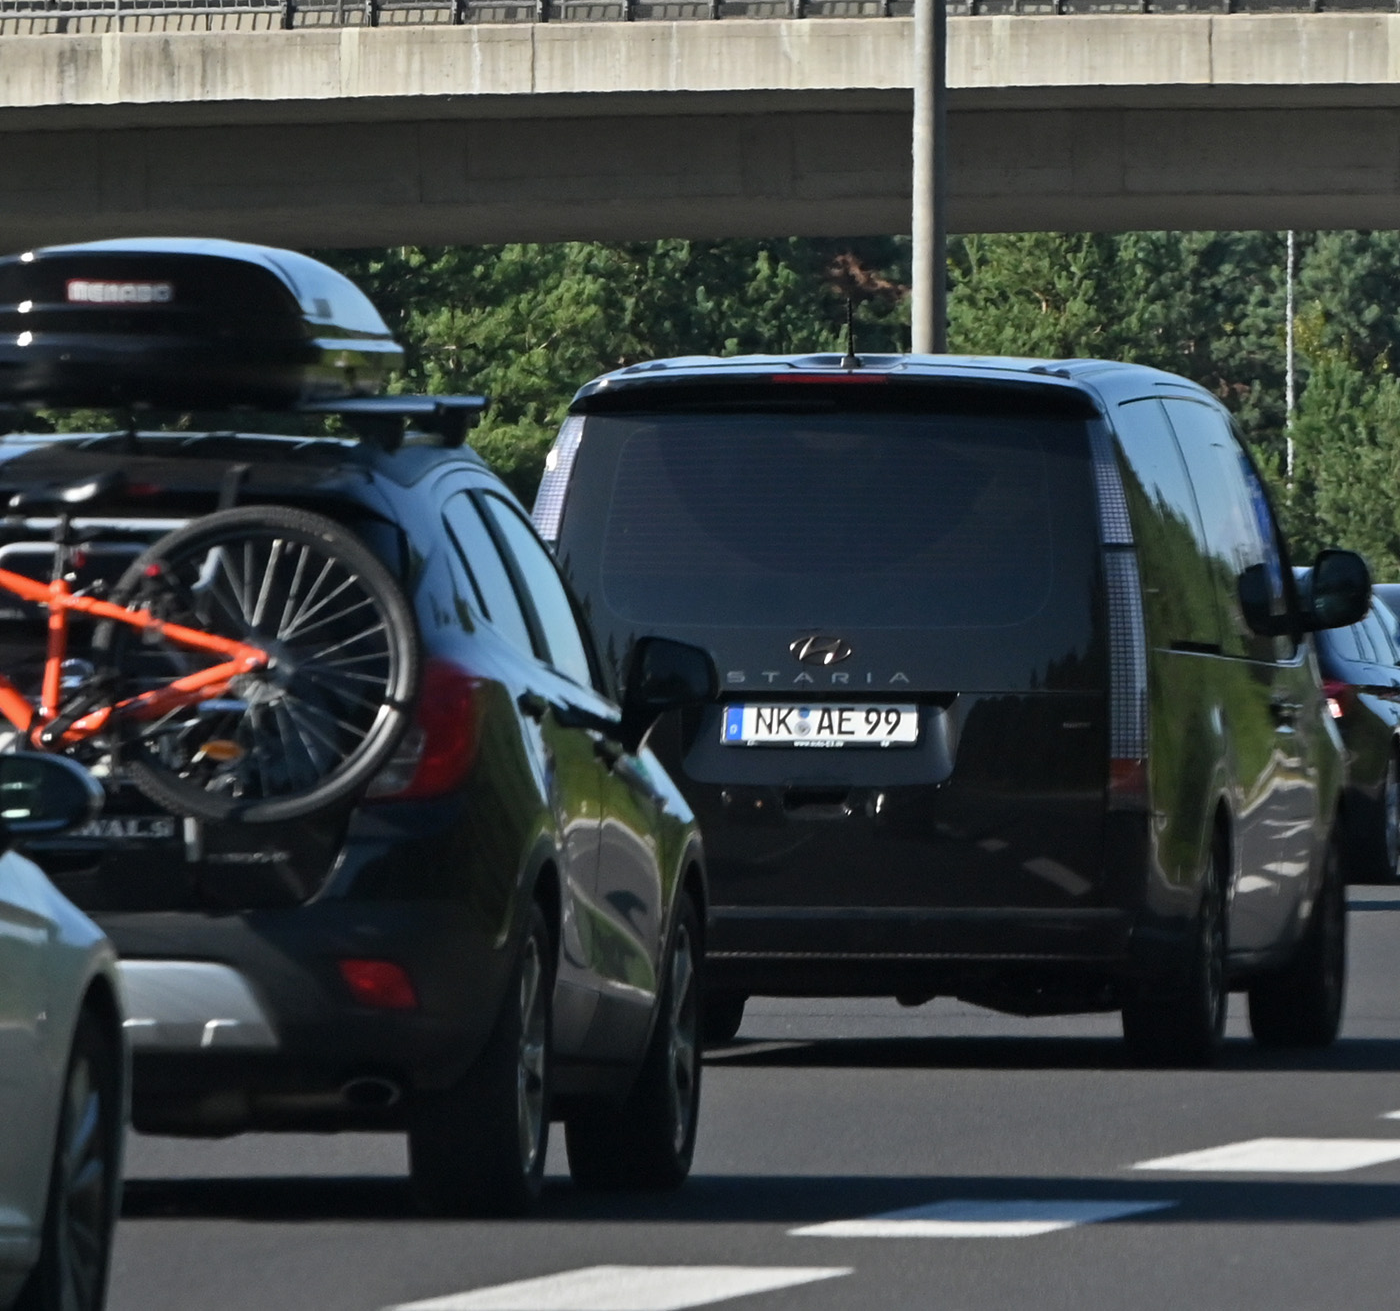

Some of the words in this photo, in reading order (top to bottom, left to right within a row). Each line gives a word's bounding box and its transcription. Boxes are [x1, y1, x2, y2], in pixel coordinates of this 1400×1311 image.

[726, 671, 910, 683] STARIA
[755, 705, 795, 735] NK
[816, 706, 855, 736] AE
[864, 707, 901, 737] 99
